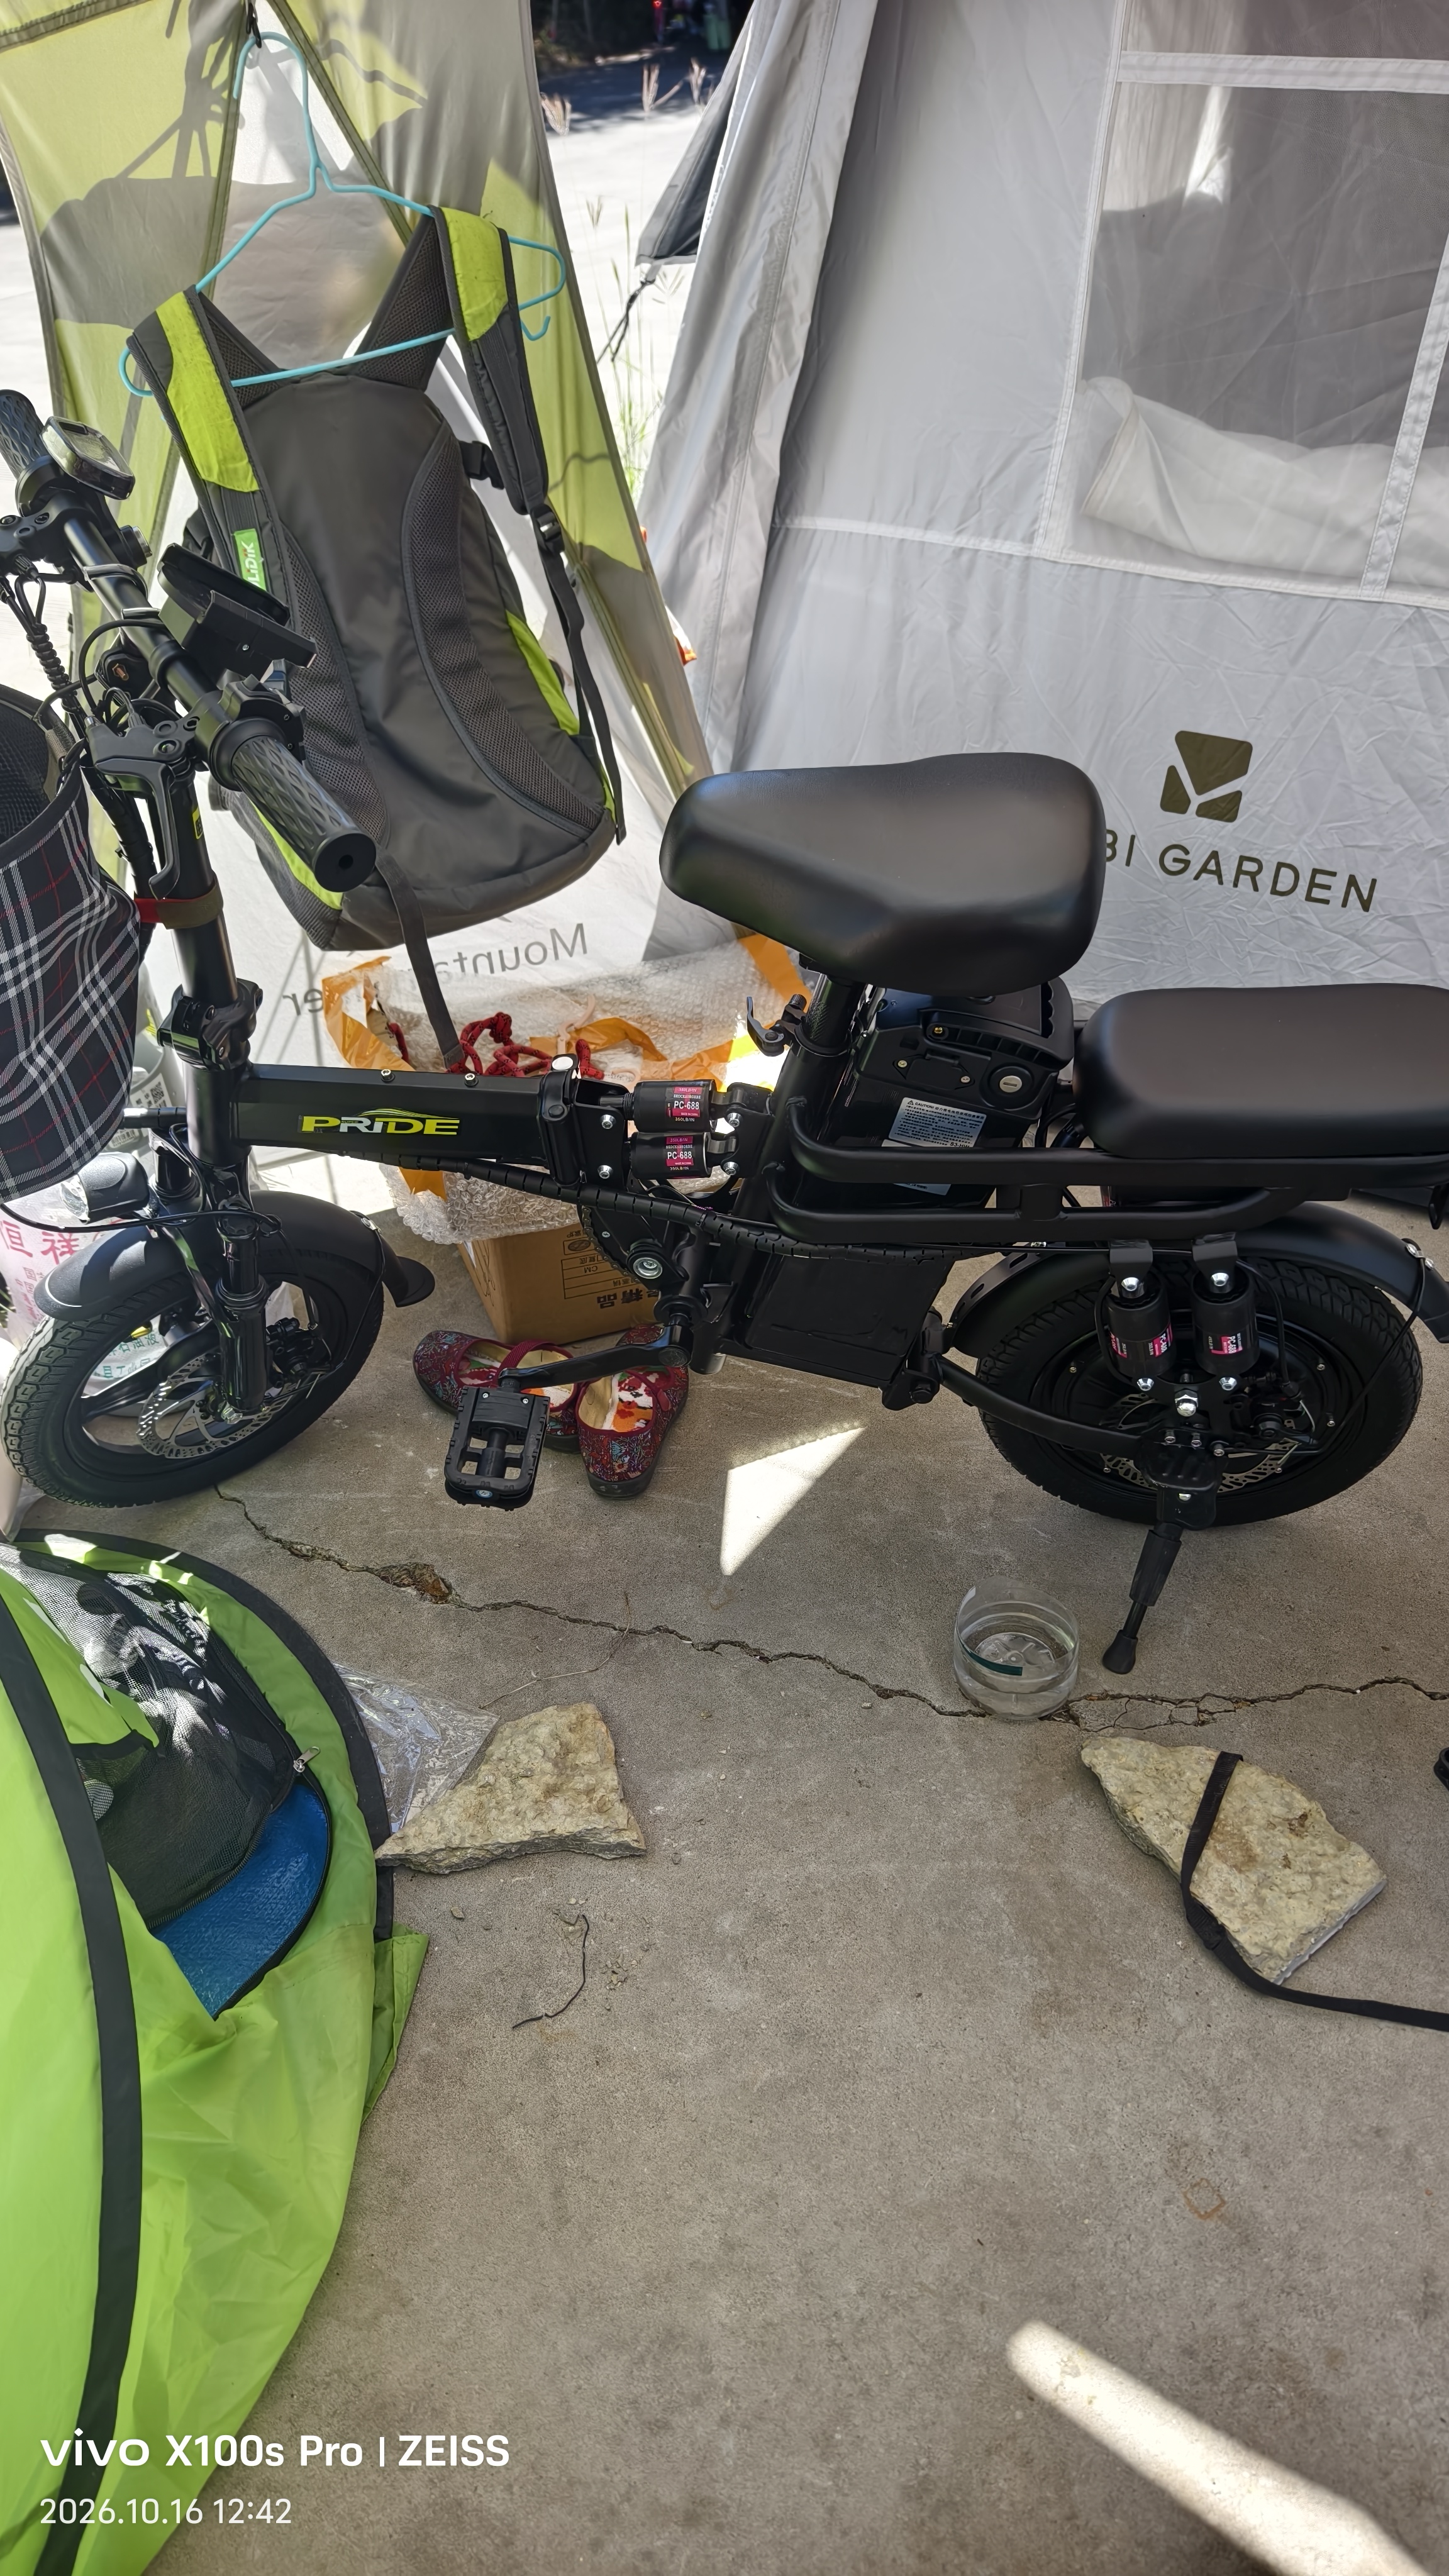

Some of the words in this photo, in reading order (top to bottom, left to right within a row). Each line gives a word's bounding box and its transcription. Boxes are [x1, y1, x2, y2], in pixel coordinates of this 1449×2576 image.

[1158, 844, 1377, 913] GARDEN
[674, 1101, 699, 1110] PC-688
[301, 1116, 460, 1135] PRIDE
[667, 1151, 692, 1160] PC-688
[584, 1265, 598, 1274] CM
